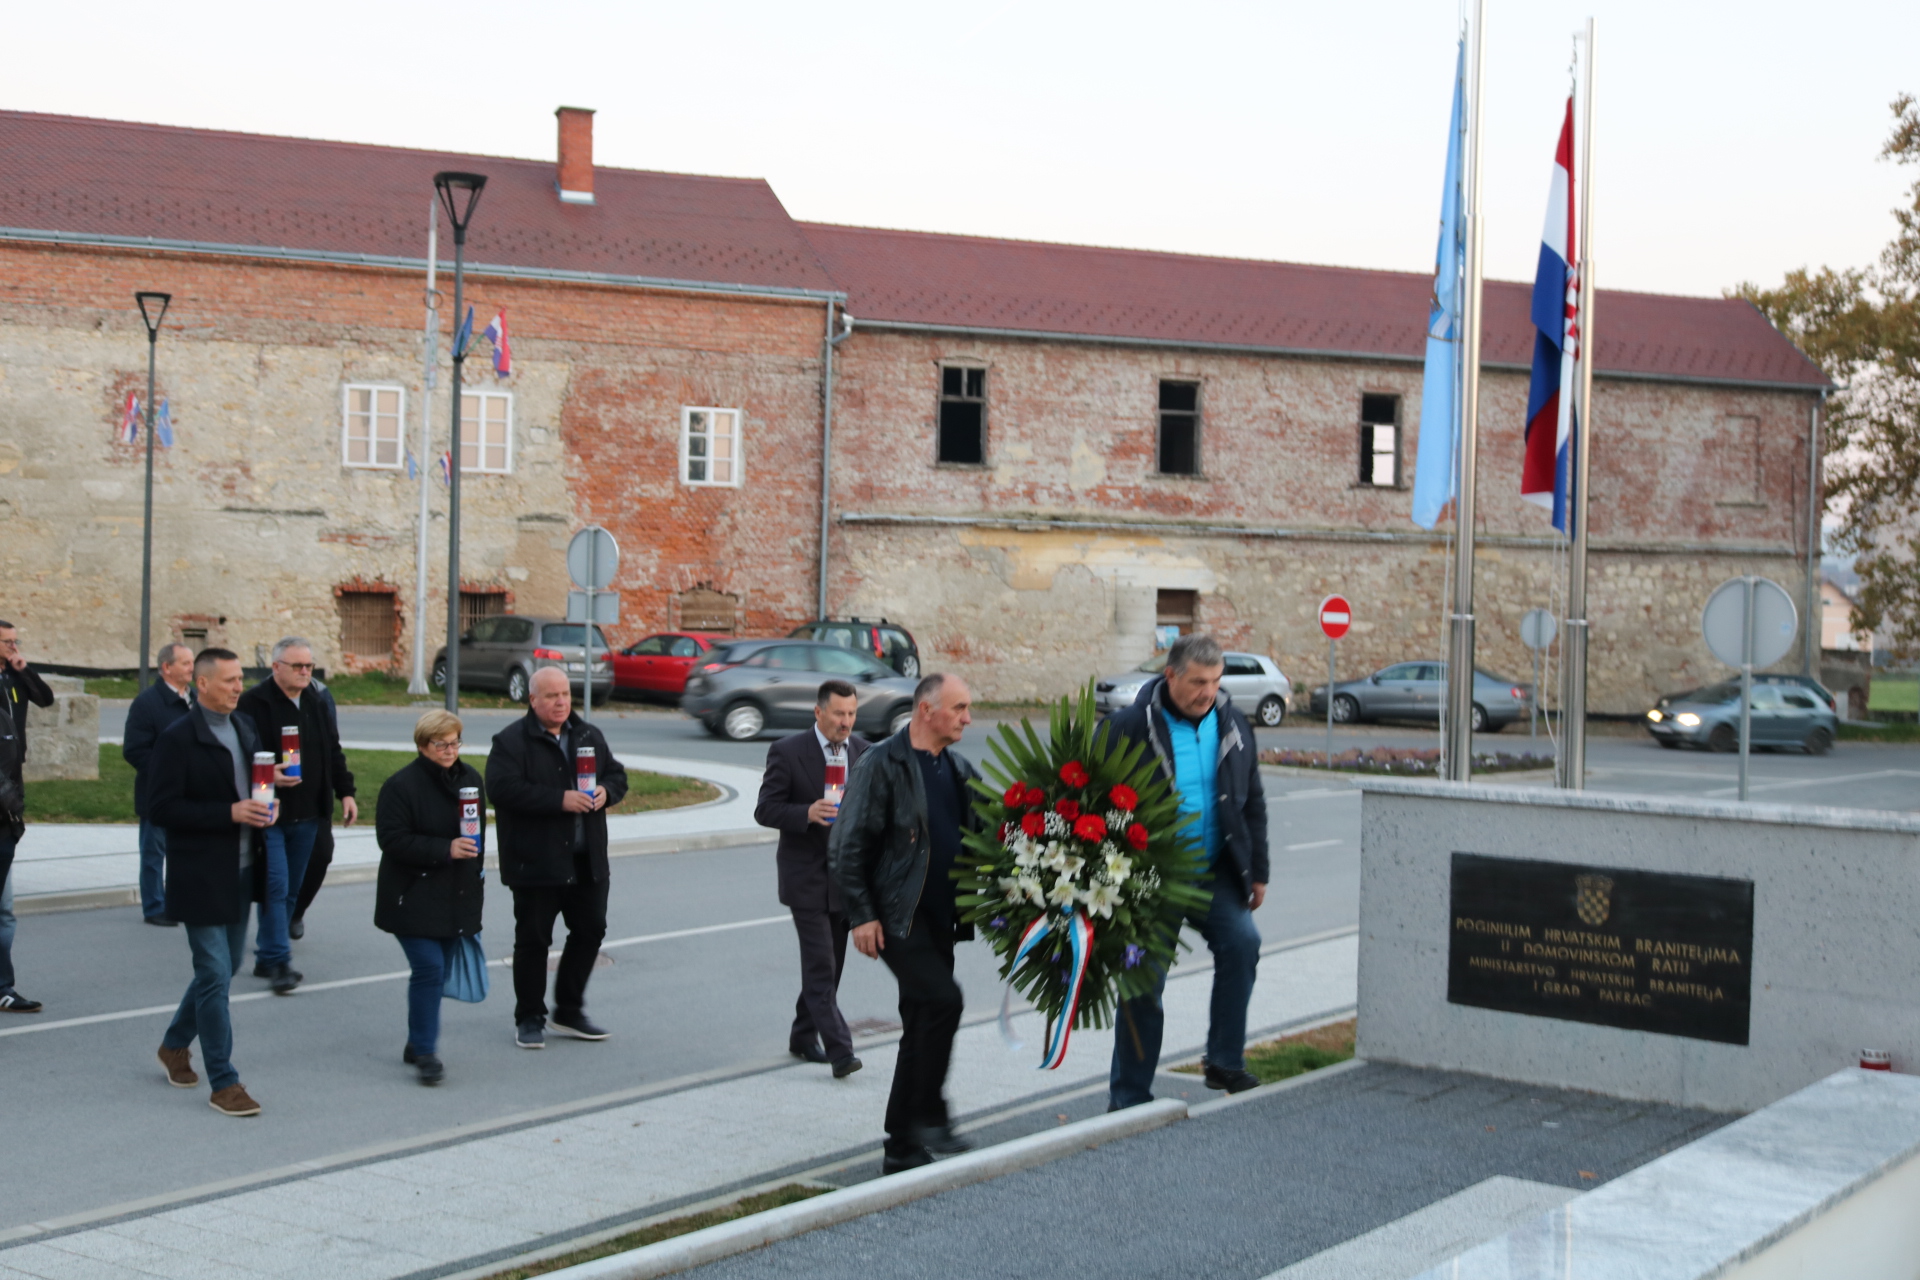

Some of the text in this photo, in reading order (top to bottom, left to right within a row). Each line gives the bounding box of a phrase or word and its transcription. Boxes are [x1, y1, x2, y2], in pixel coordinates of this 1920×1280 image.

[1456, 917, 1531, 938] POGINULIM
[1545, 928, 1621, 949] HRVATSKIM
[1469, 956, 1555, 977] MINISTARSTVO
[1571, 969, 1635, 988] HRVATSKIH
[1524, 943, 1635, 969] DOMOVINSKOM
[1652, 958, 1690, 975] RATU
[1543, 982, 1580, 997] GRAD
[1599, 989, 1652, 1007] PAKRAC
